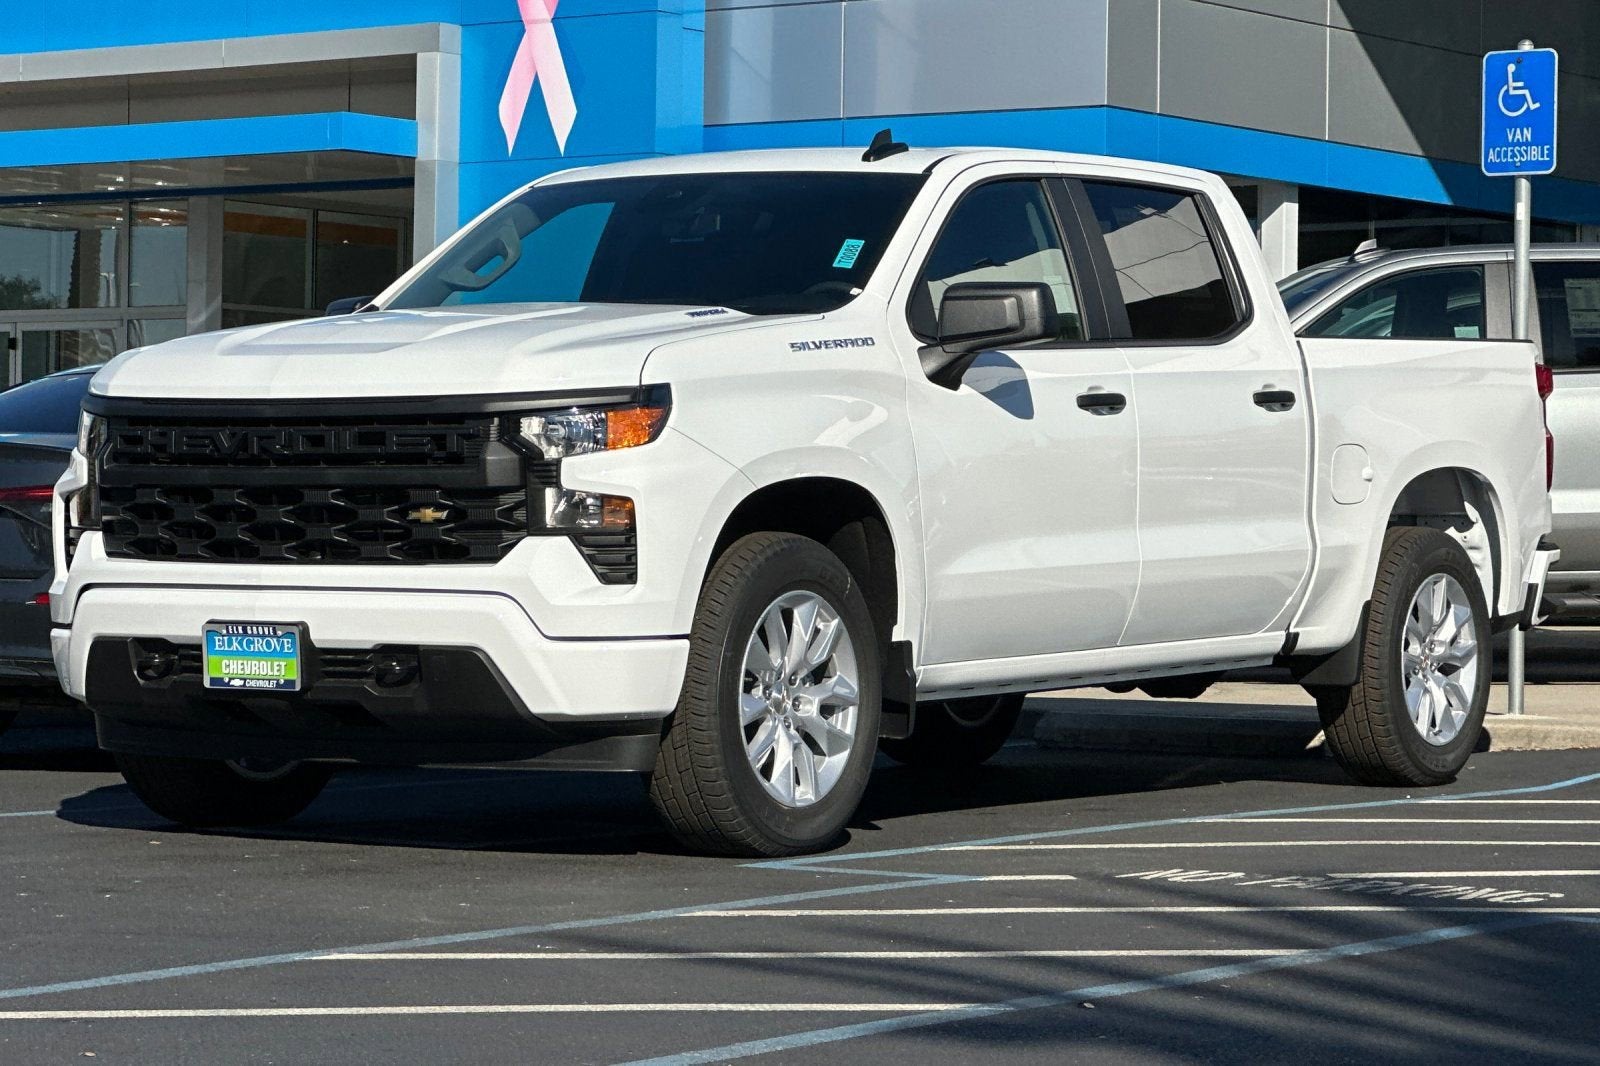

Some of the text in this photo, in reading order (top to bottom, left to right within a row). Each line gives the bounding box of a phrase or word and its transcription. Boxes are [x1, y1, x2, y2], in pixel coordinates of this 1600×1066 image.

[1506, 127, 1532, 143] VAN
[1488, 145, 1550, 163] ACCESSIBLE
[789, 337, 875, 353] SILVERADO
[113, 426, 474, 456] CHEVROLET
[228, 625, 274, 635] ELK GROVE
[214, 636, 294, 653] ELK GROVE
[221, 659, 287, 676] CHEVROLET
[245, 679, 277, 688] CHEVROLET
[1115, 868, 1565, 904] NO PARKING
